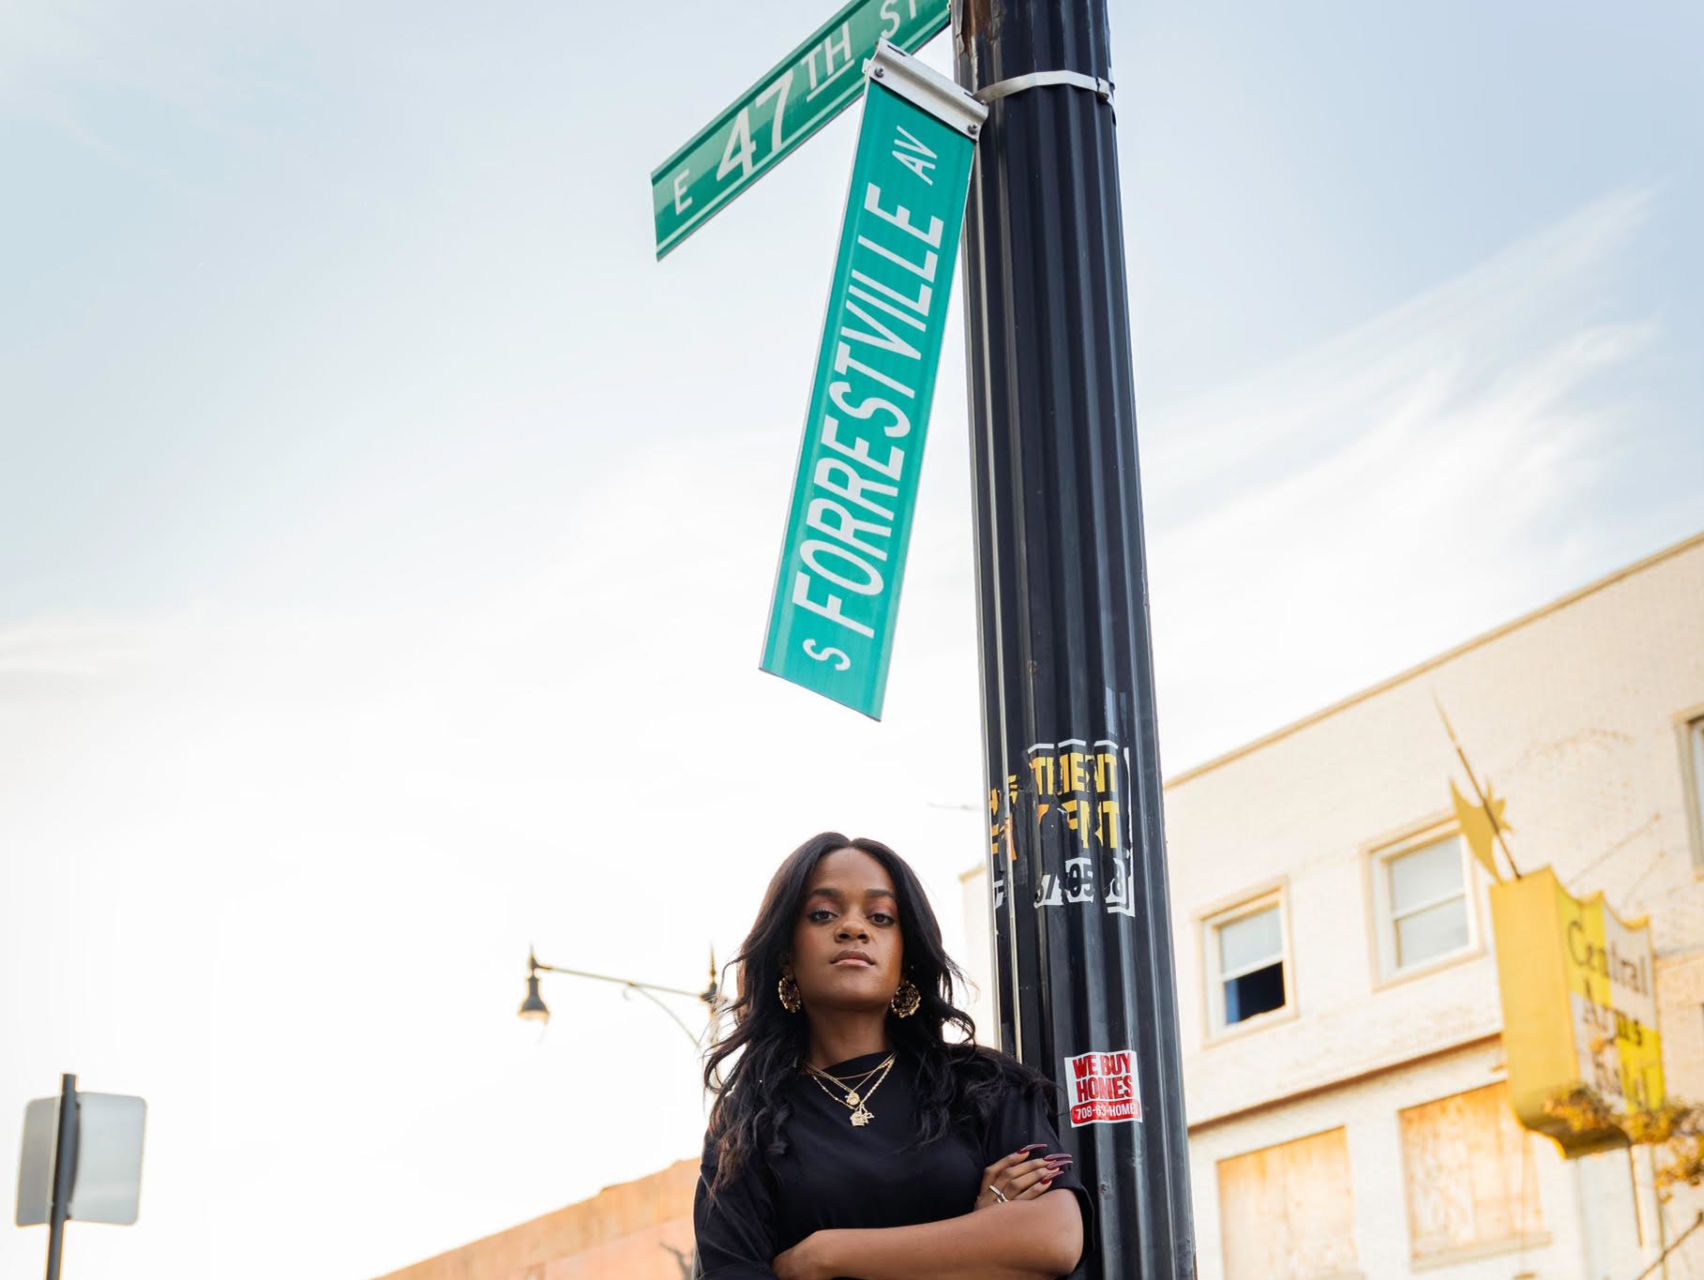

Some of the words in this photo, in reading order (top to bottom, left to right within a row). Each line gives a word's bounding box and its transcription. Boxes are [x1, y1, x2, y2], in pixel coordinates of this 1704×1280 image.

[892, 125, 938, 186] AV
[673, 169, 693, 215] E
[792, 182, 944, 639] FORRESTVILLE
[802, 637, 851, 671] S
[1072, 1054, 1098, 1079] WE
[1100, 1053, 1131, 1076] BUY
[1076, 1075, 1134, 1103] HOMES
